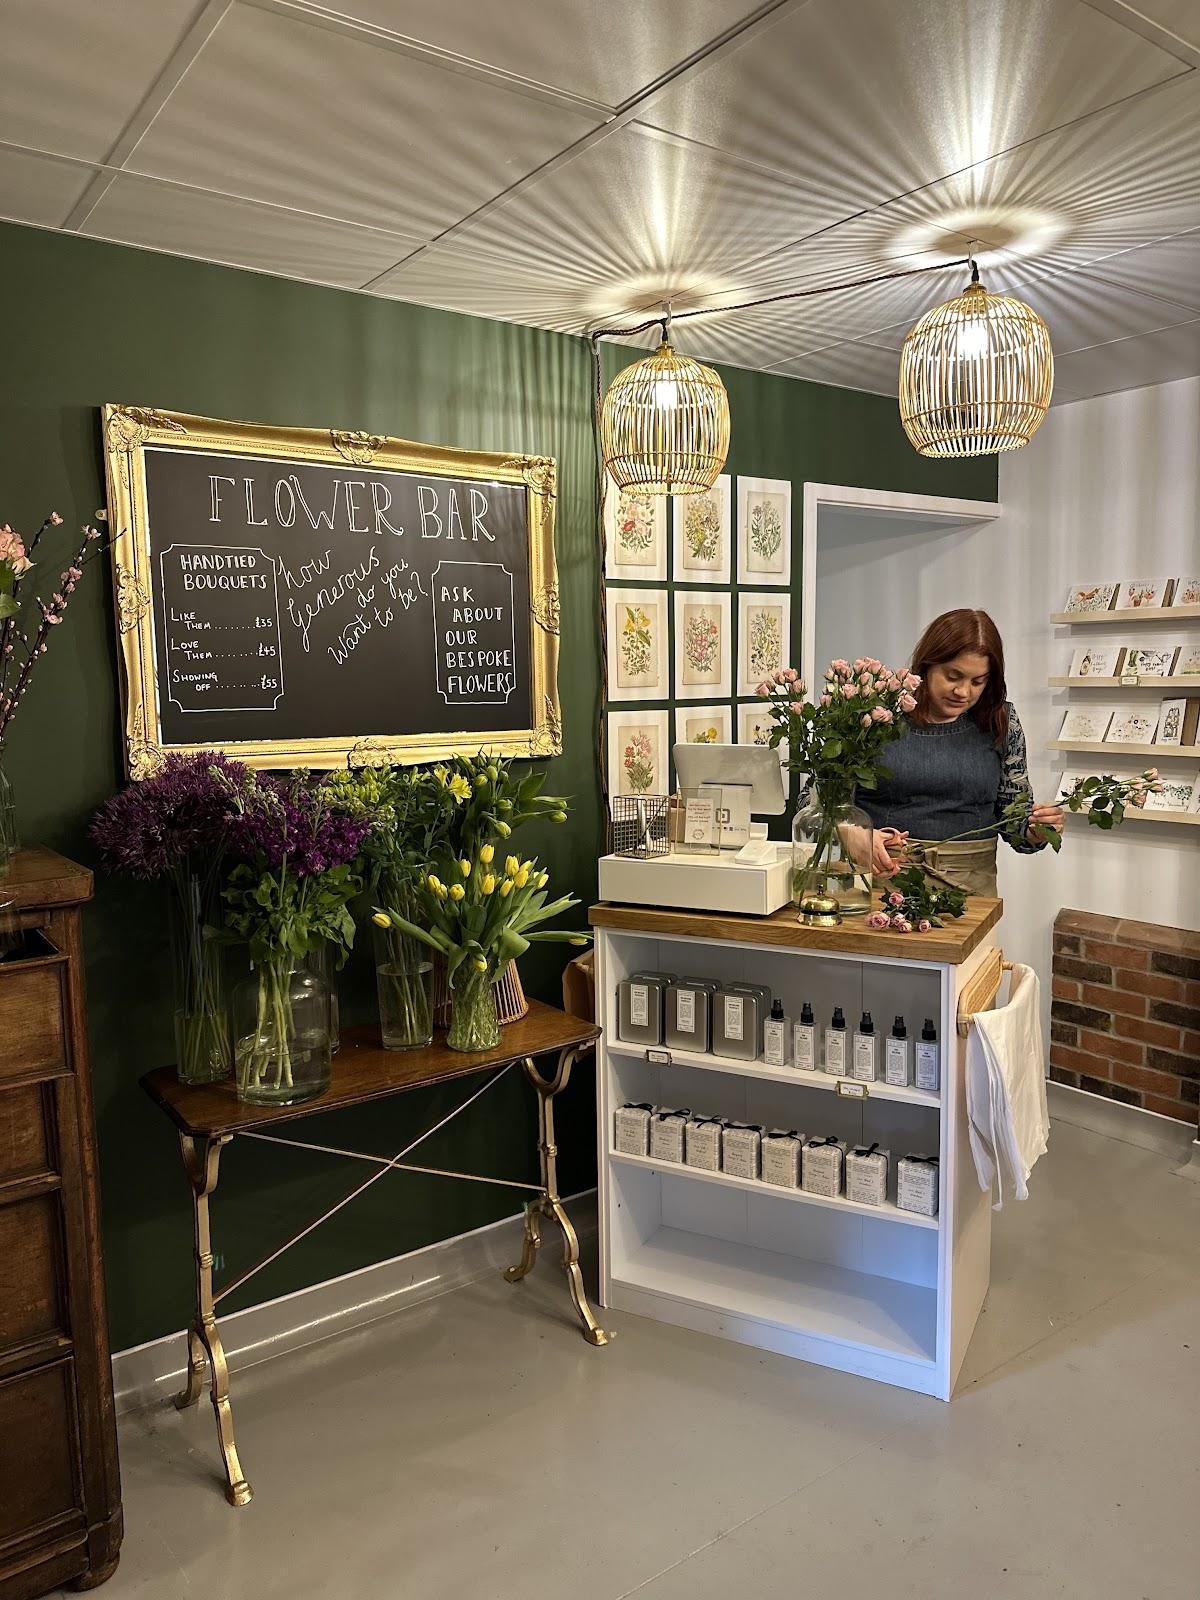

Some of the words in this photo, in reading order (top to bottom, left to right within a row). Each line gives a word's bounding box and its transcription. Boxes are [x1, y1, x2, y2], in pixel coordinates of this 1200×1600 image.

[208, 475, 403, 536] FLOWER
[417, 485, 496, 541] BAR
[180, 554, 256, 571] HANDTIED
[278, 550, 331, 589] how
[183, 573, 267, 591] BOUQUETS
[357, 585, 375, 608] do
[381, 559, 408, 599] you
[374, 607, 394, 627] to
[398, 572, 429, 609] be?
[441, 586, 475, 602] ASK
[171, 607, 196, 621] LIKE
[453, 607, 503, 624] ABOUT
[184, 620, 211, 630] THEM
[255, 616, 273, 628] £35
[171, 638, 199, 650] LOVE
[445, 630, 478, 646] OUR
[184, 650, 213, 660] THEM
[258, 642, 276, 656] £45
[446, 650, 512, 668] BESPOKE
[172, 669, 218, 682] SHOWING
[261, 674, 278, 689] £55
[448, 672, 513, 694] FLOWERS
